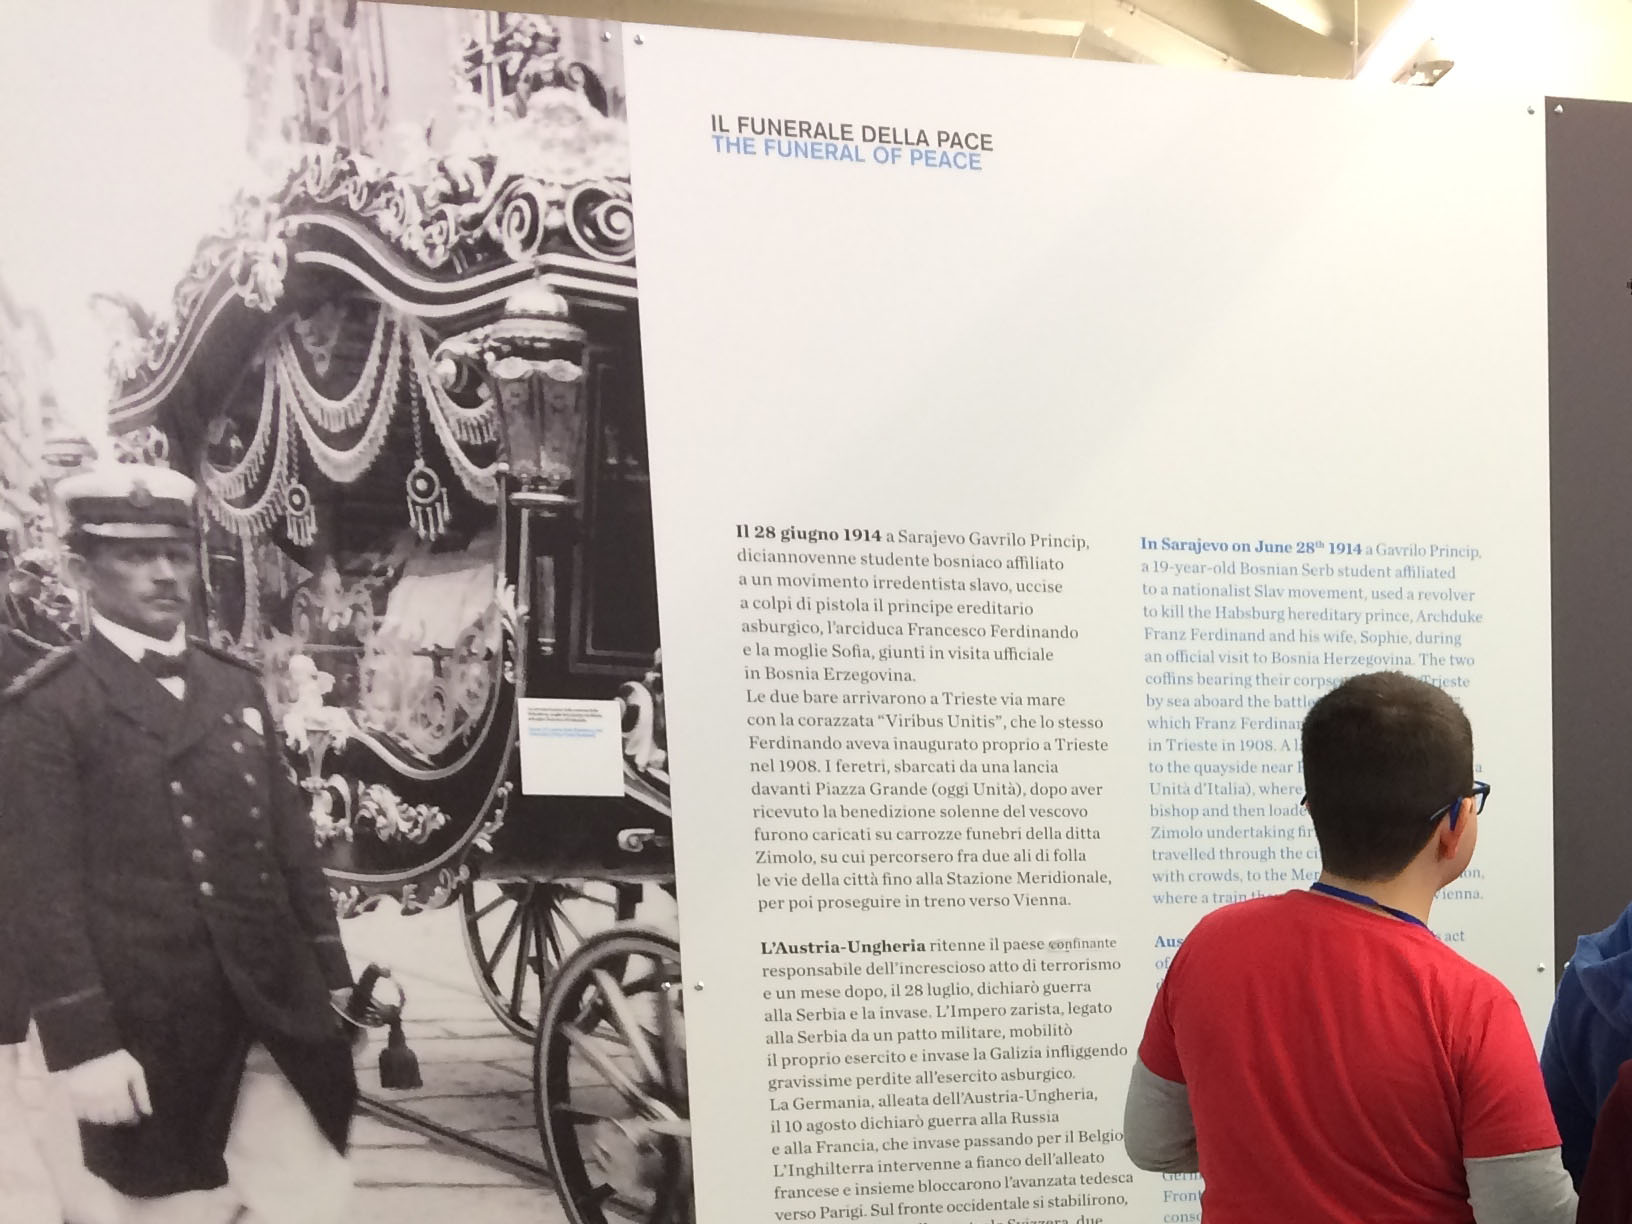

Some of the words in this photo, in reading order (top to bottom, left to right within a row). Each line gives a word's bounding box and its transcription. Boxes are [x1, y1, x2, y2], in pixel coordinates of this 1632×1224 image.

[711, 114, 730, 133] IL
[737, 116, 854, 142] FUNERALE
[861, 124, 930, 147] DELLA
[936, 130, 993, 152] PACE
[711, 135, 757, 155] THE
[763, 138, 866, 163] FUNERAL
[872, 145, 902, 165] OF
[909, 148, 982, 171] PEACE
[735, 523, 749, 538] Il
[754, 525, 776, 539] 28
[780, 525, 839, 544] giugno
[843, 528, 882, 542] 1914
[886, 532, 895, 543] a
[898, 529, 965, 547] Sarajevo
[968, 531, 1026, 547] Gavrilo
[1030, 533, 1089, 551] Princip,
[736, 547, 856, 565] diciannovenne
[860, 551, 929, 567] studente
[932, 552, 1002, 569] bosniaco
[1006, 555, 1064, 571] affiliato
[1141, 536, 1158, 550] In
[1161, 537, 1229, 555] Sarajevo
[1231, 542, 1251, 553] on
[1254, 540, 1293, 553] June
[1328, 542, 1362, 556] 1914
[1365, 547, 1373, 555] a
[1375, 543, 1426, 557] Gavrilo
[1430, 544, 1482, 561] Princip,
[738, 575, 747, 586] a
[751, 575, 773, 586] un
[776, 572, 869, 589] movimento
[873, 574, 966, 591] irredentista
[969, 577, 1013, 594] slavo,
[1015, 579, 1063, 593] uccise
[1142, 583, 1158, 596] to
[1160, 586, 1169, 596] a
[1172, 582, 1251, 598] nationalist
[1254, 583, 1285, 598] Slav
[1288, 587, 1368, 602] movement,
[1371, 586, 1403, 600] used
[1406, 590, 1415, 601] a
[1417, 587, 1476, 602] revolver
[1144, 626, 1187, 641] Franz
[1190, 627, 1265, 642] Ferdinand
[1268, 628, 1295, 643] and
[1299, 628, 1320, 643] his
[1323, 629, 1357, 645] wife,
[1360, 630, 1412, 647] Sophie,
[1415, 630, 1462, 648] during
[1144, 652, 1162, 663] an
[1165, 649, 1215, 664] official
[1218, 650, 1249, 664] visit
[1252, 651, 1268, 664] to
[1271, 650, 1320, 665] Bosnia
[1418, 652, 1446, 666] The
[1449, 653, 1475, 667] two
[744, 665, 761, 680] in
[764, 665, 819, 681] Bosnia
[823, 666, 916, 685] Erzegovina.
[748, 735, 842, 750] Ferdinando
[845, 739, 890, 750] aveva
[893, 736, 978, 754] inaugurato
[982, 737, 1039, 754] proprio
[1043, 741, 1052, 751] a
[1054, 737, 1108, 751] Trieste
[749, 758, 775, 772] nel
[779, 759, 821, 773] 1908.
[825, 759, 831, 773] I
[835, 758, 890, 775] feretri,
[893, 758, 956, 773] sbarcati
[959, 759, 978, 773] da
[981, 763, 1010, 773] una
[1013, 759, 1059, 774] lancia
[752, 804, 819, 819] ricevuto
[822, 803, 837, 818] la
[839, 803, 936, 819] benedizione
[939, 804, 1000, 818] solenne
[1002, 803, 1026, 818] del
[1028, 807, 1088, 818] vescovo
[1149, 803, 1199, 821] bishop
[1202, 803, 1229, 817] and
[1232, 803, 1265, 817] then
[1269, 803, 1308, 818] loade
[755, 849, 817, 865] Zimolo,
[820, 853, 838, 864] su
[841, 849, 866, 864] cui
[869, 852, 954, 867] percorsero
[957, 848, 978, 863] fra
[982, 848, 1010, 863] due
[1013, 848, 1032, 862] ali
[1035, 848, 1050, 862] di
[1053, 848, 1087, 862] folla
[929, 938, 986, 952] ritenne
[990, 937, 999, 951] il
[1003, 940, 1045, 954] paese
[762, 990, 772, 1000] e
[775, 989, 796, 1000] un
[800, 988, 841, 999] mese
[844, 984, 887, 1001] dopo,
[890, 983, 901, 997] il
[904, 983, 924, 997] 28
[927, 981, 974, 999] luglio,
[976, 980, 1040, 995] dichiarò
[1042, 982, 1092, 997] guerra
[765, 1030, 794, 1045] alla
[797, 1029, 847, 1044] Serbia
[850, 1028, 870, 1042] da
[872, 1031, 893, 1042] un
[896, 1028, 937, 1044] patto
[940, 1025, 1005, 1040] militare,
[1009, 1022, 1072, 1038] mobilitò
[767, 1052, 778, 1067] il
[781, 1051, 841, 1070] proprio
[844, 1049, 906, 1064] esercito
[909, 1052, 918, 1062] e
[922, 1048, 969, 1062] invase
[972, 1047, 986, 1061] la
[989, 1045, 1042, 1060] Galizia
[1045, 1042, 1128, 1061] infliggendo
[770, 1119, 781, 1134] il
[785, 1119, 803, 1133] 10
[806, 1118, 857, 1135] agosto
[860, 1113, 924, 1130] dichiarò
[927, 1116, 978, 1130] guerra
[980, 1111, 1007, 1126] alla
[1010, 1111, 1060, 1124] Russia
[774, 1210, 816, 1221] verso
[819, 1203, 867, 1221] Parigi.
[870, 1202, 894, 1217] Sul
[897, 1201, 944, 1216] fronte
[946, 1196, 1030, 1213] occidentale
[1032, 1195, 1044, 1209] si
[1047, 1193, 1128, 1208] stabilirono,
